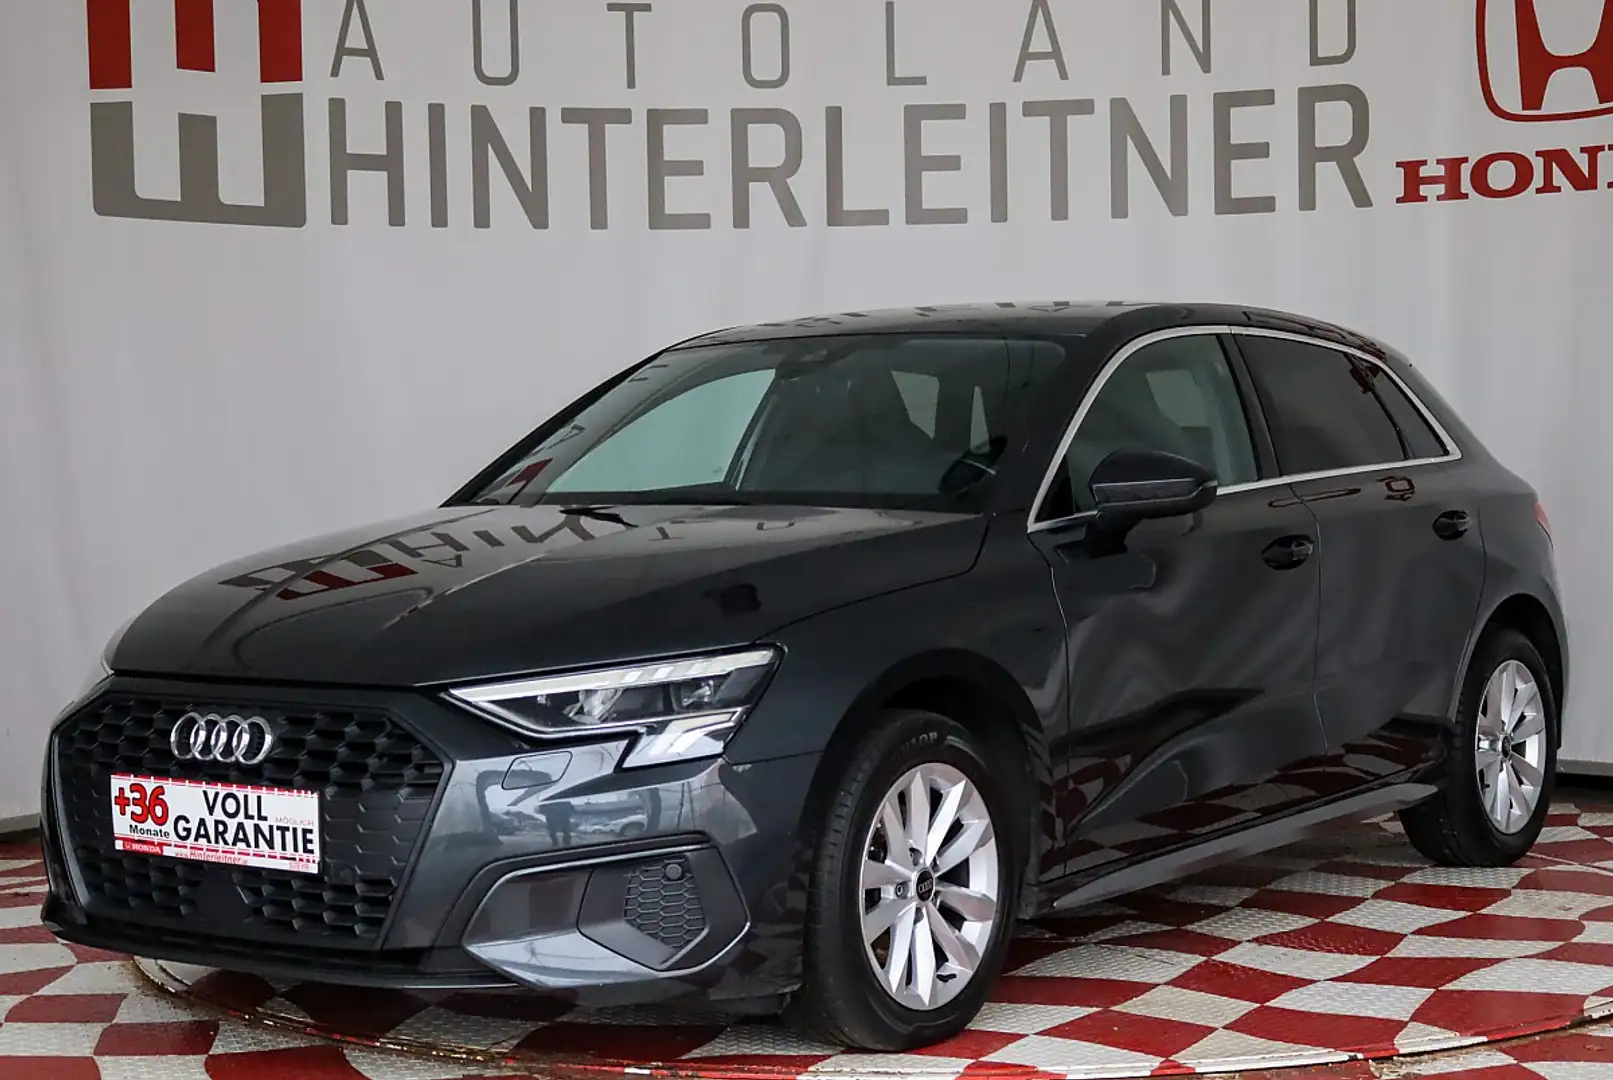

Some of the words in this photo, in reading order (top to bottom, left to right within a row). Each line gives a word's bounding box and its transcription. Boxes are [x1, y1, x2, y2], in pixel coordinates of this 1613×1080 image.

[328, 84, 1374, 230] HINTERLEITNER
[1395, 143, 1613, 204] HON
[114, 783, 169, 826] +36
[202, 790, 268, 821] VOLL
[129, 824, 171, 839] Monate
[131, 843, 161, 854] HONDA
[173, 814, 315, 854] GARANTIE
